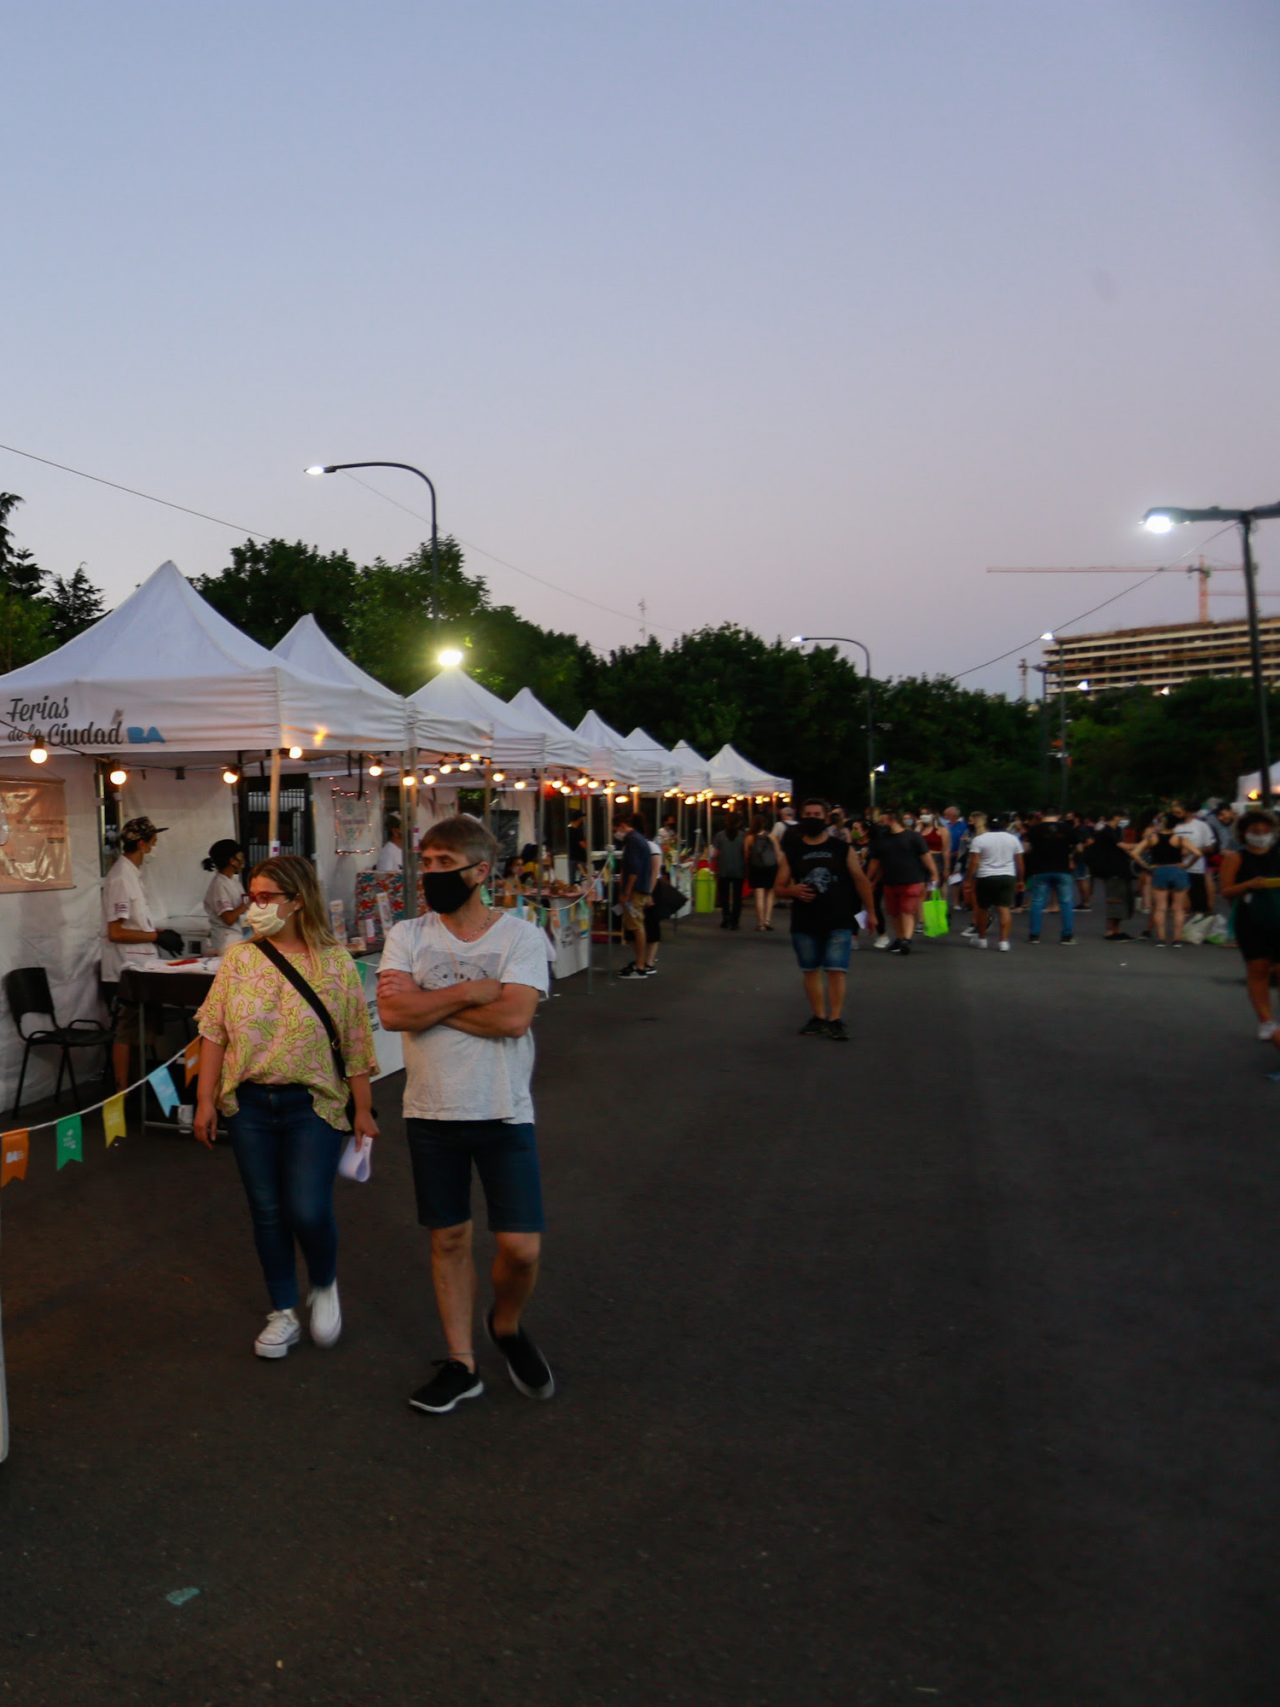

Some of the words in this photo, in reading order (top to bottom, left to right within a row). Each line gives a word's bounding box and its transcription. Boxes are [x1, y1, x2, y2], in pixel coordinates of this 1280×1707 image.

[6, 696, 69, 722] Ferias
[8, 727, 24, 742] de
[47, 721, 124, 747] Ciudad
[127, 726, 166, 744] BA
